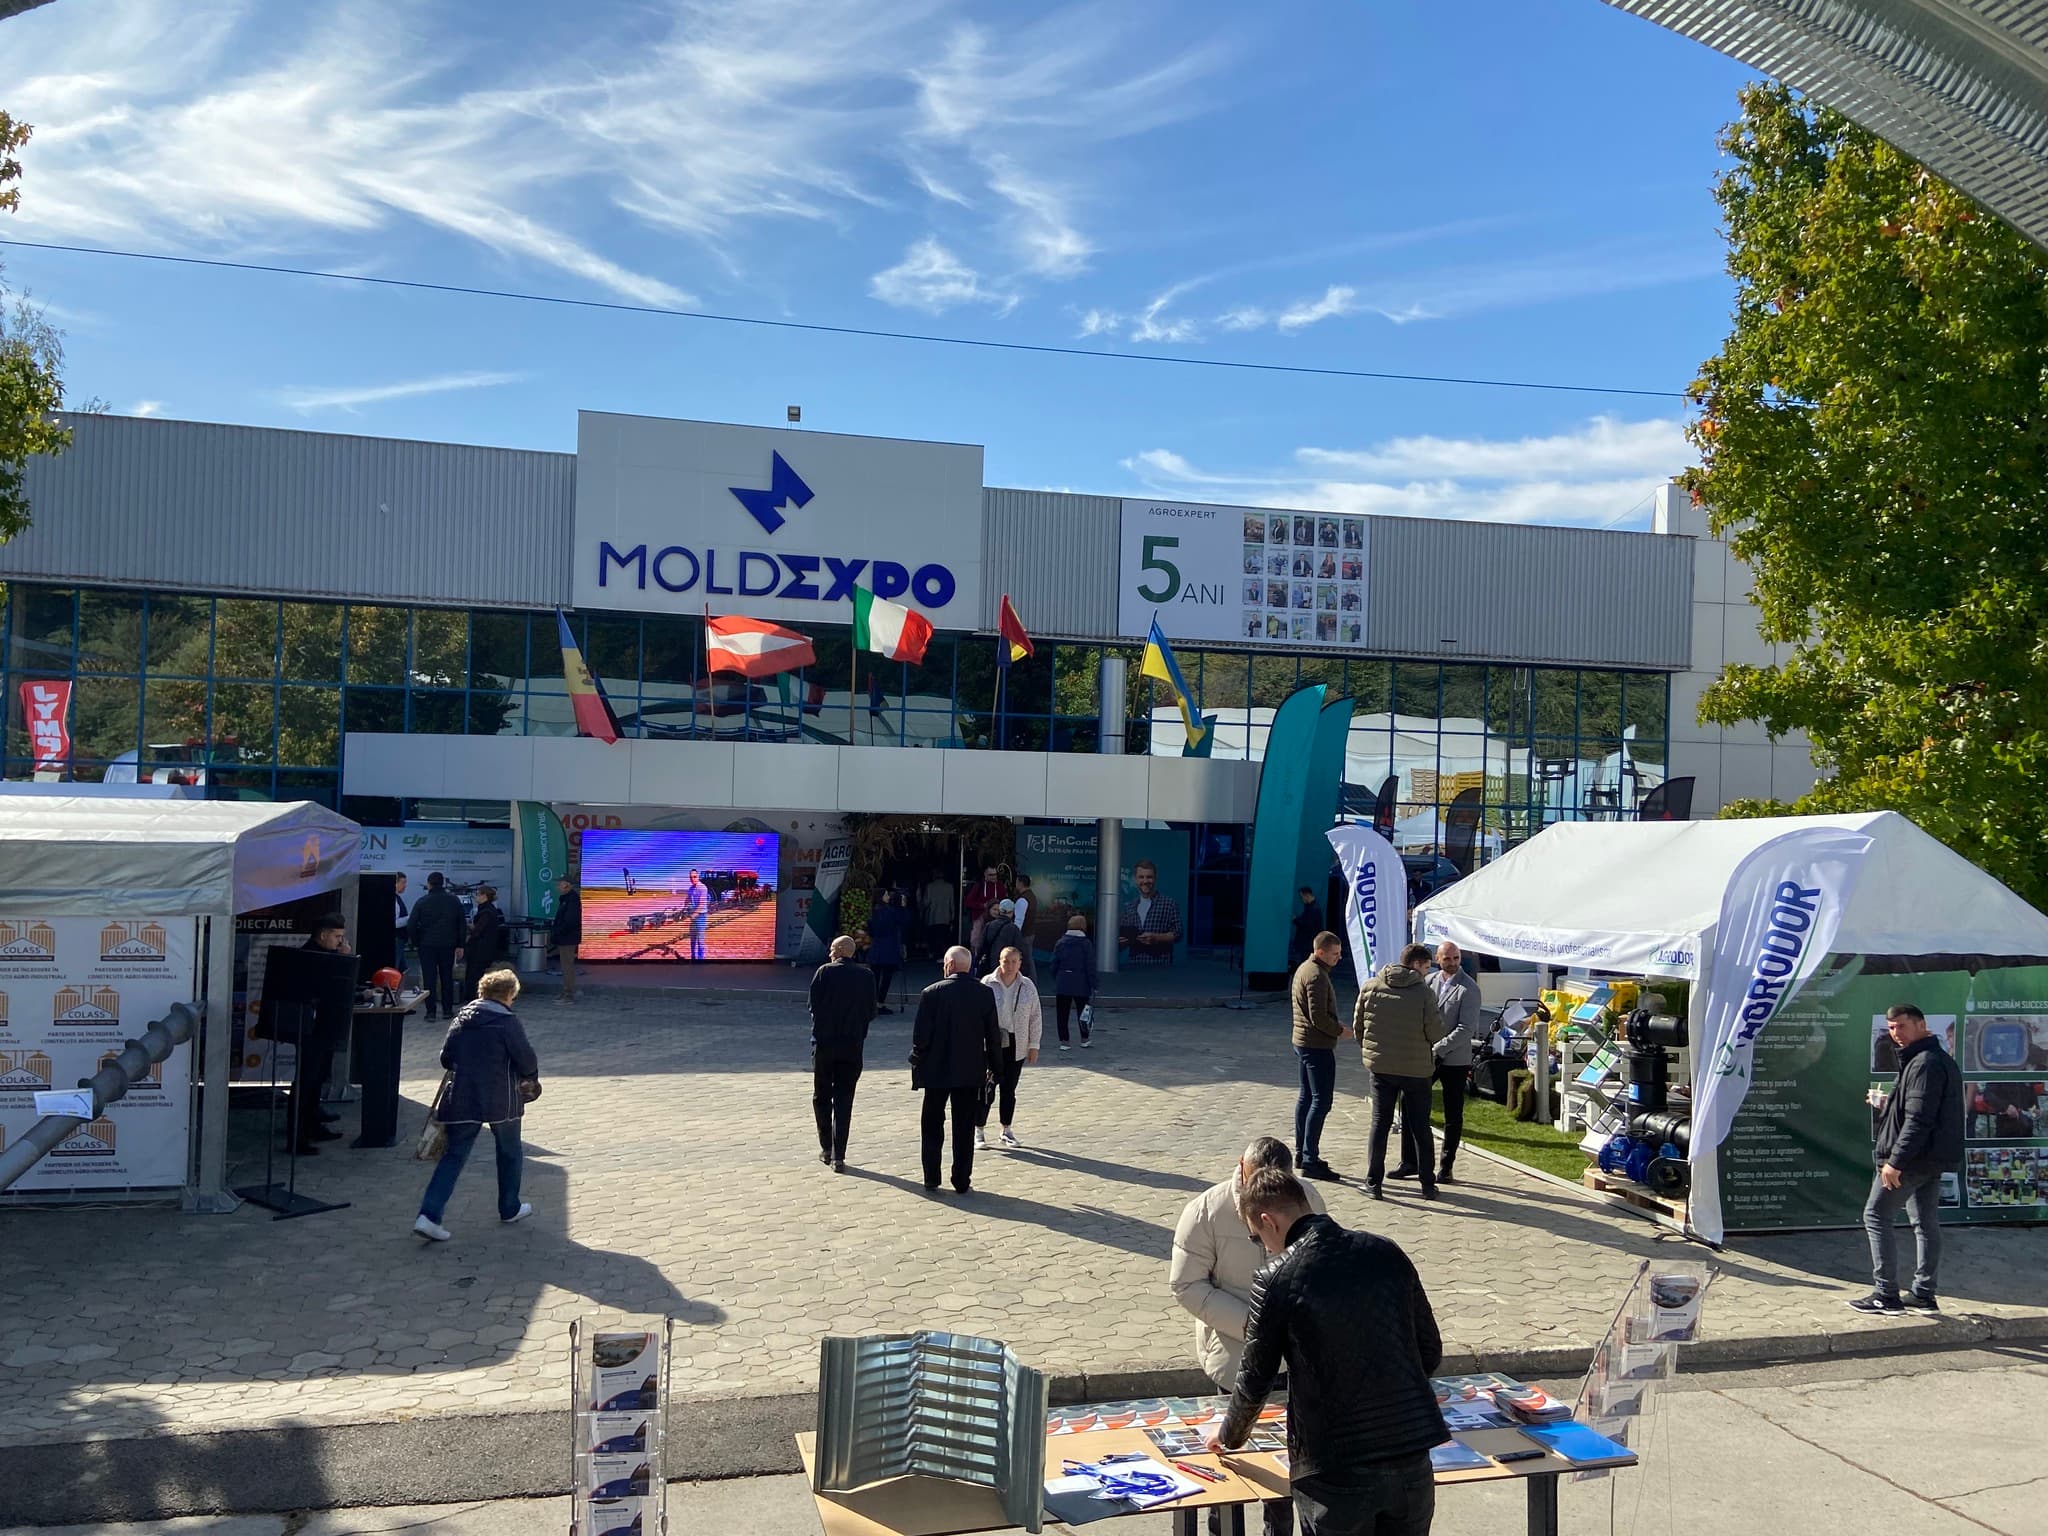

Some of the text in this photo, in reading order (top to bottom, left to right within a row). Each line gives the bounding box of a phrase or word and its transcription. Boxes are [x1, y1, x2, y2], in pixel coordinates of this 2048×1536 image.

[1148, 507, 1217, 520] AGROEXPERT
[599, 540, 956, 608] MOLDEXPO
[1136, 535, 1224, 606] 5 ANI
[235, 919, 293, 929] OIECTARE
[114, 946, 152, 954] COLASS
[68, 1010, 105, 1019] COLASS
[0, 1076, 38, 1084] COLASS
[64, 1141, 102, 1149] COLASS
